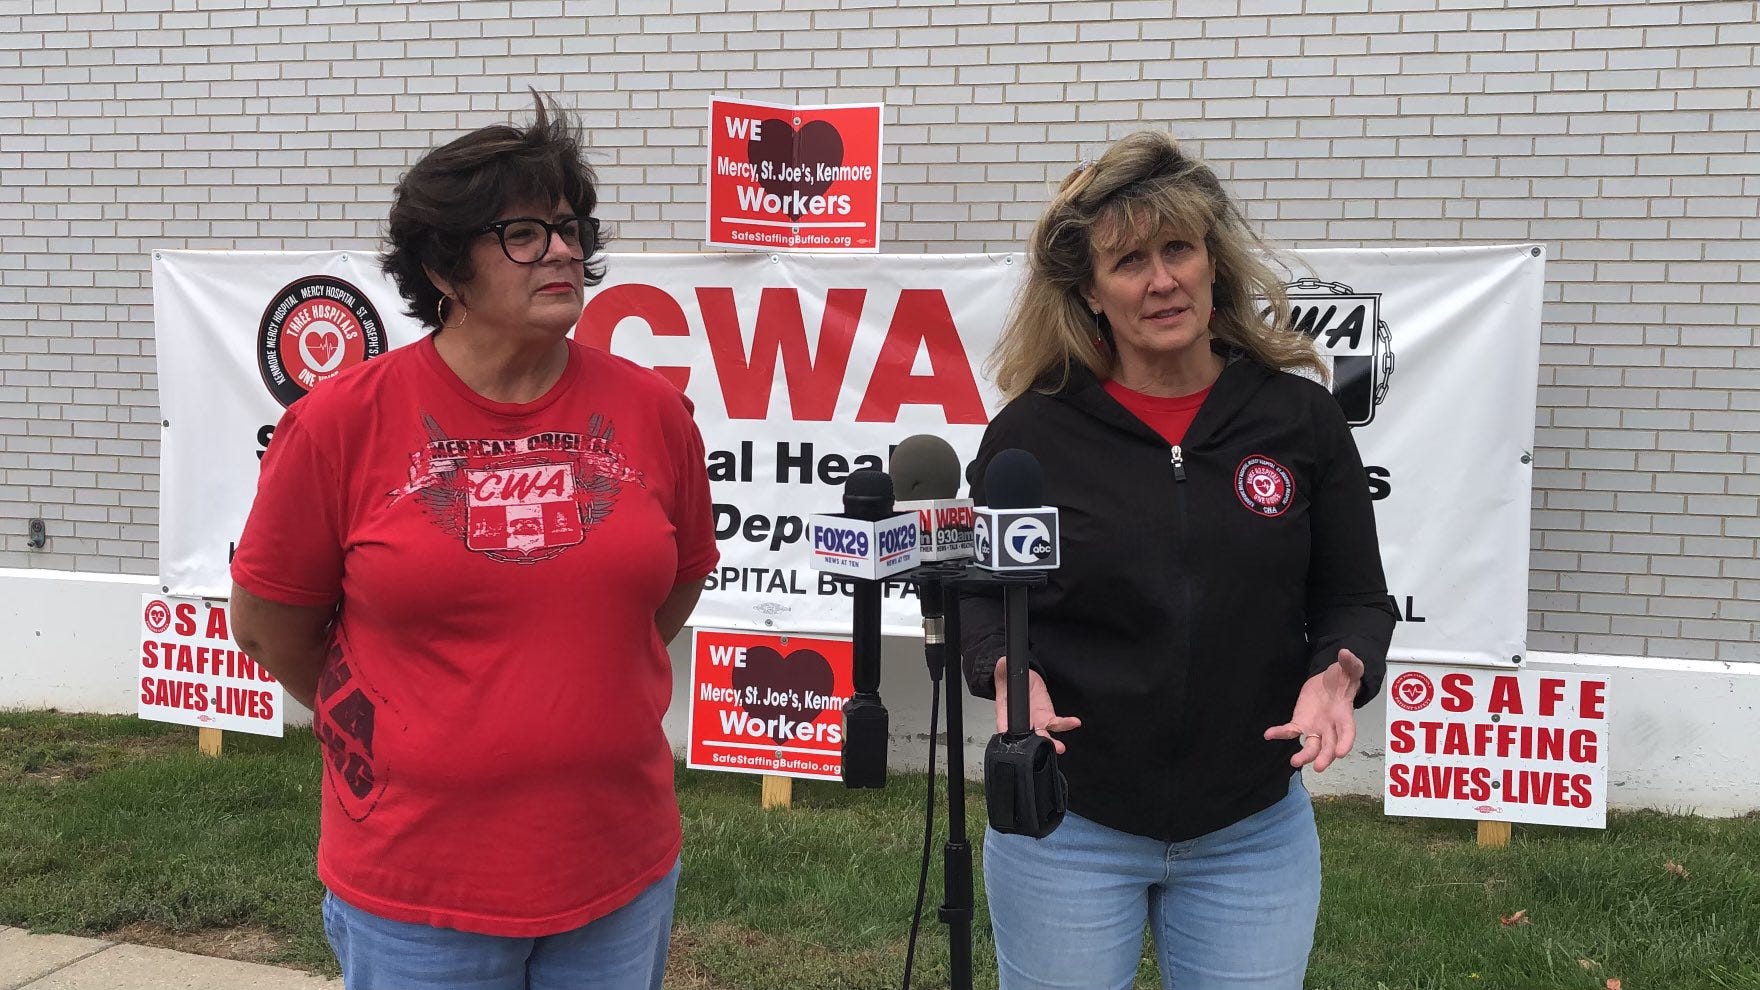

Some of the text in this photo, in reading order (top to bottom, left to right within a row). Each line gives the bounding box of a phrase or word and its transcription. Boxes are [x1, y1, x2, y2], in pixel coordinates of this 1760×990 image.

[725, 116, 762, 142] WE
[717, 155, 872, 185] Mercy, St. Joe's, Kenmore
[736, 185, 852, 215] Workers
[731, 230, 852, 247] SafeStaffingBuffalo.org
[300, 285, 325, 299] MERCY
[325, 286, 356, 309] HOSPITAL
[272, 294, 299, 324] HOSPITAL
[286, 304, 358, 340] THREE HOSPITALS
[355, 306, 368, 320] ST.
[266, 321, 280, 348] MERCY
[362, 319, 380, 355] JOSEPH'S
[1259, 304, 1366, 350] WA
[266, 348, 286, 386] KENMORE
[573, 283, 990, 425] CWA
[297, 368, 317, 388] ONE
[474, 469, 566, 502] CWA
[935, 506, 974, 529] WBEN
[814, 525, 869, 557] FOX29
[879, 522, 917, 557] FOX29
[937, 529, 974, 544] 930am
[1032, 543, 1052, 554] abc
[825, 556, 839, 565] NEWS
[849, 560, 859, 568] TEN
[886, 559, 898, 567] NEWS
[704, 566, 807, 595] SPITAL
[174, 603, 229, 641] SA
[709, 644, 747, 668] WE
[141, 676, 274, 721] SAVES LIVES
[700, 682, 850, 711] Mercy, St. Joe's, Kenm
[1440, 673, 1606, 719] SAFE
[719, 709, 842, 744] Workers
[1389, 720, 1598, 764] STAFFING
[712, 753, 842, 774] SafeStaffingBuffalo.org
[1389, 763, 1593, 809] SAVES LIVES
